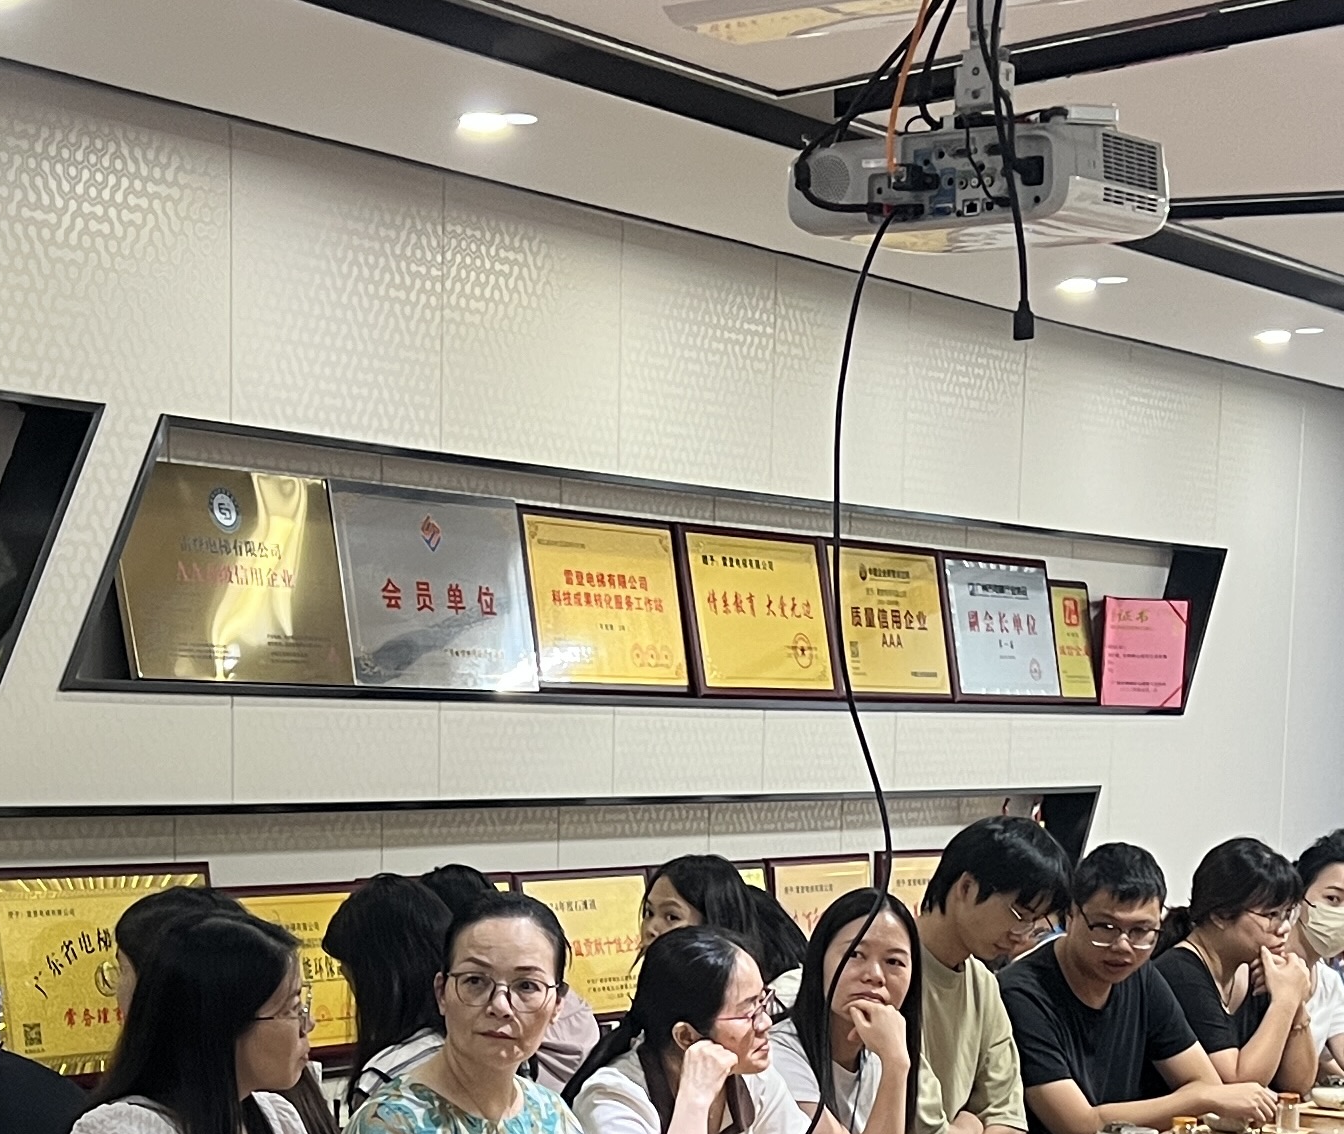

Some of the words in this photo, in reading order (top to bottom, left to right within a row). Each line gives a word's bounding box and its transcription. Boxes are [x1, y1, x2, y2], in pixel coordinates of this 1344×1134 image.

[381, 577, 498, 617] 会员单位
[851, 606, 928, 631] 质量信用企业
[882, 632, 903, 648] AAA
